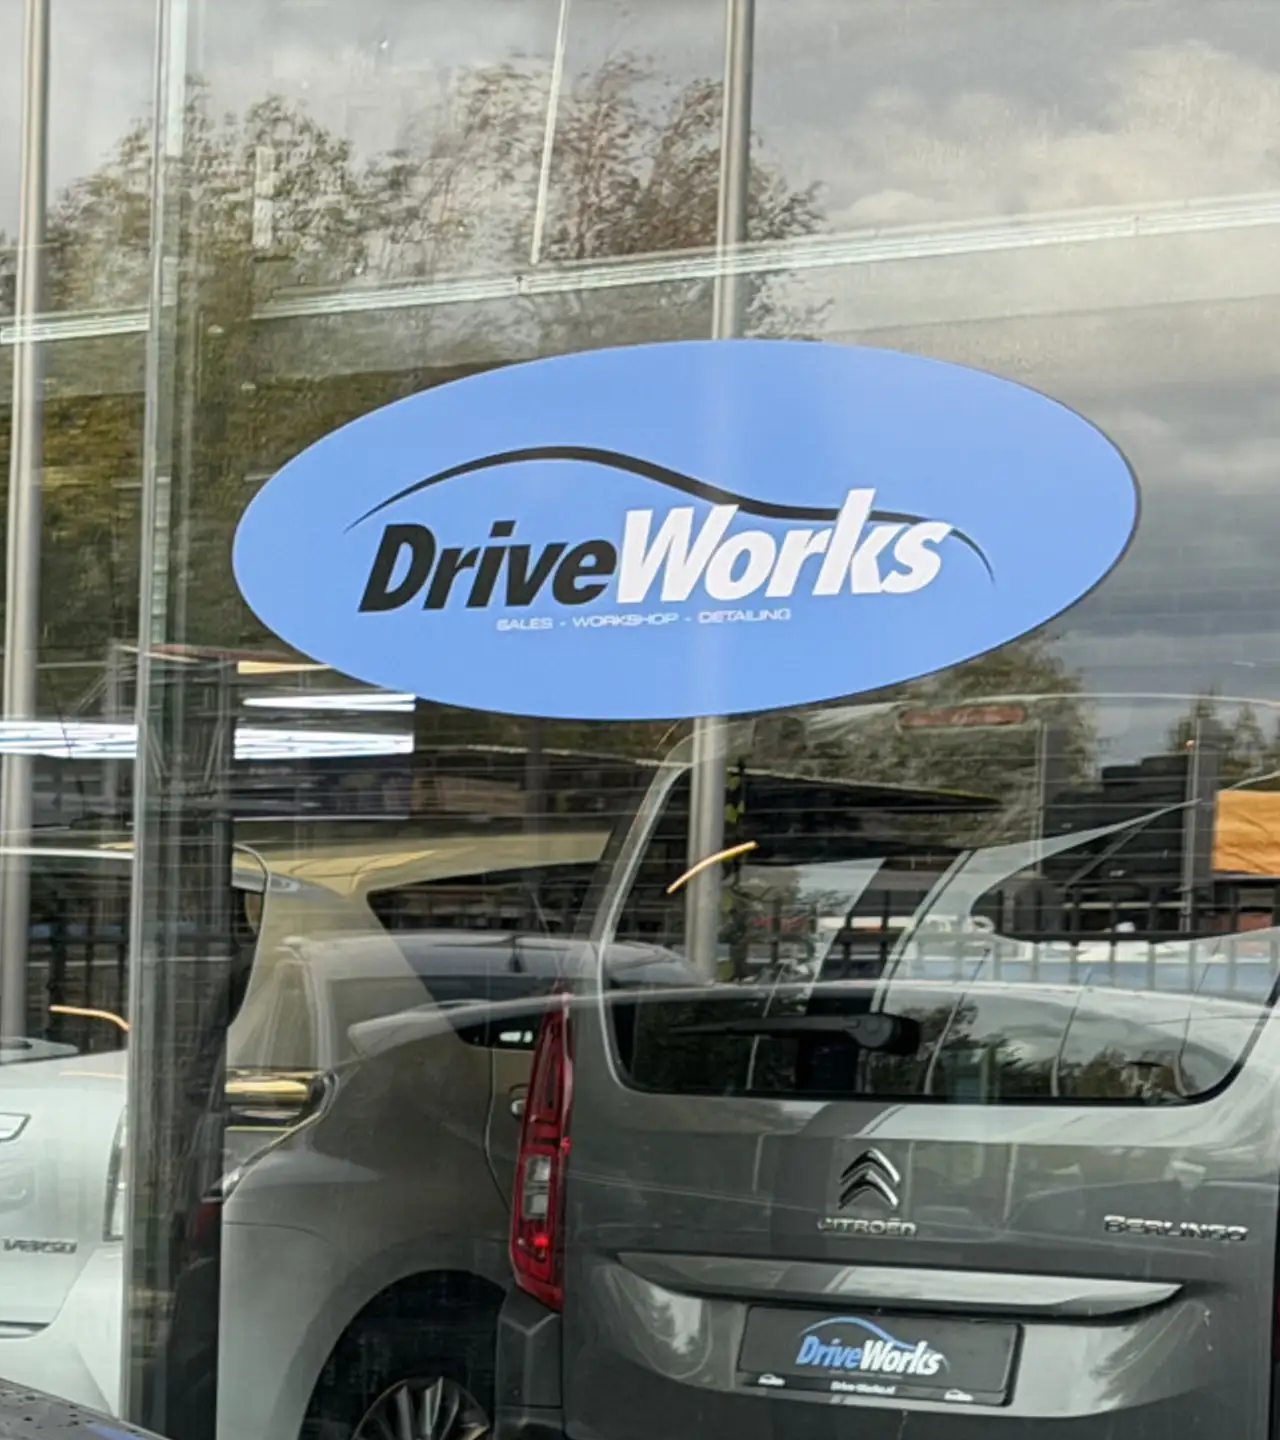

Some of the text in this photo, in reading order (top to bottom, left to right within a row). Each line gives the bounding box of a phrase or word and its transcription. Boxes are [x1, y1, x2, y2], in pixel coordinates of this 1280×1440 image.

[357, 487, 954, 614] DriveWorks
[496, 617, 553, 632] SALES
[572, 612, 680, 629] WORKSHOP
[698, 607, 792, 625] DETAILING
[1103, 1213, 1249, 1242] BERLINGO
[795, 1335, 944, 1376] DriveWorks
